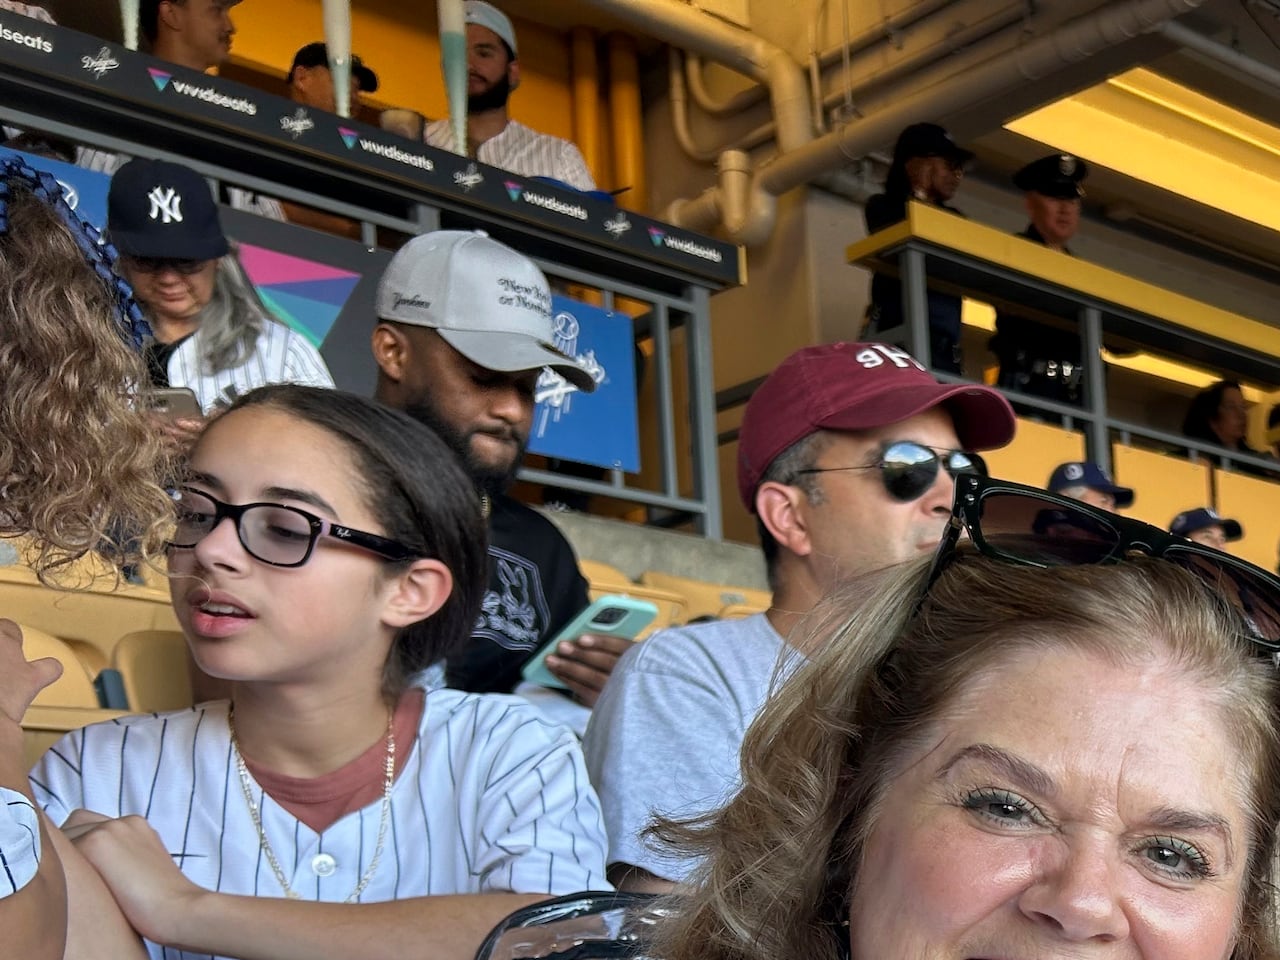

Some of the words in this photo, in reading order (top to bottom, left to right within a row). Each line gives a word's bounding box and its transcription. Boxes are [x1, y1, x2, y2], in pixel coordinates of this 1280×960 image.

[172, 79, 257, 116] vividseats
[358, 138, 435, 171] vividseats
[147, 185, 183, 224] NY
